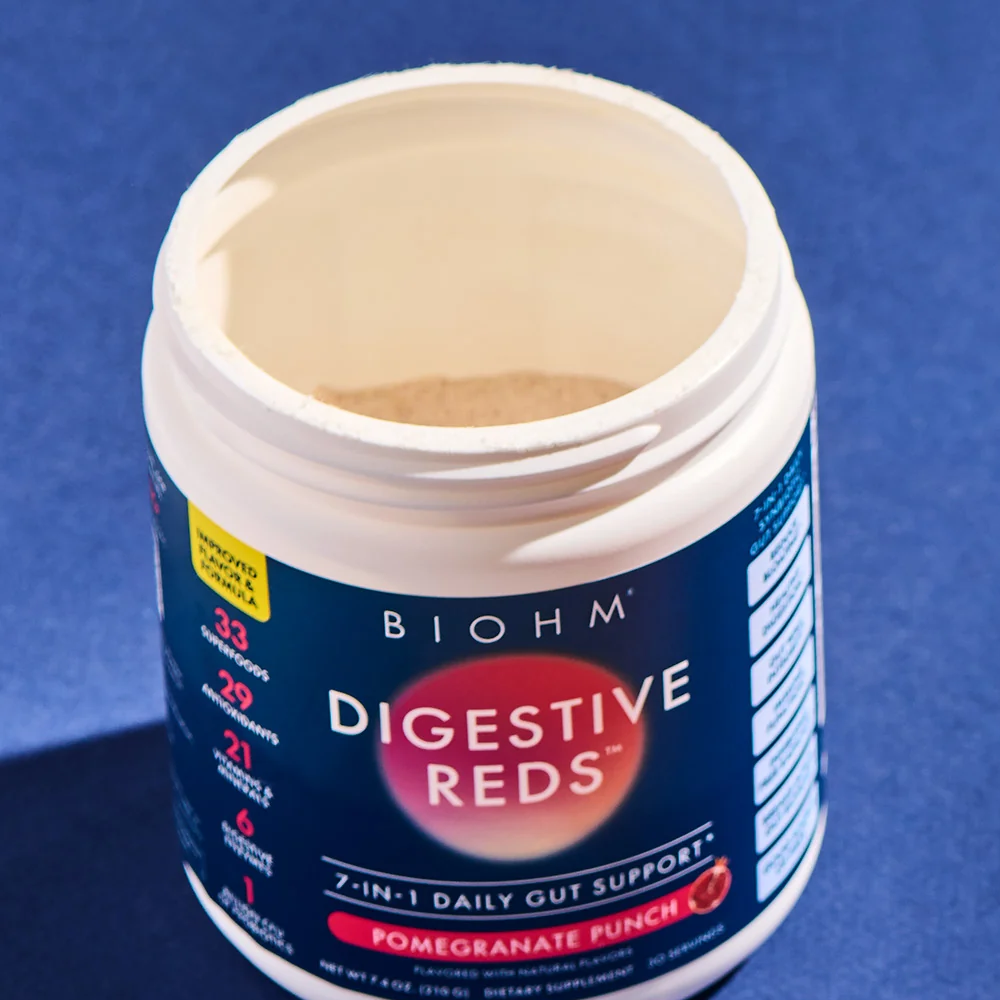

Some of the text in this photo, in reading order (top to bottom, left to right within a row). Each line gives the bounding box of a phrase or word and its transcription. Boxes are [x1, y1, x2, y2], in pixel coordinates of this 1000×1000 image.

[196, 527, 258, 578] IMPROVED
[199, 544, 254, 591] FLAVOR &
[201, 560, 258, 609] FORMULA
[214, 607, 249, 651] 33
[201, 624, 270, 682] SUPERFOODS
[218, 669, 253, 711] 29
[329, 659, 691, 751] DIGESTIVE
[202, 683, 279, 746] ANTIOXIDANTS
[224, 729, 251, 769] 21
[236, 808, 255, 837] 6
[243, 875, 254, 904] 1
[335, 871, 418, 906] 7-IN-1
[433, 891, 513, 911] DAILY
[525, 883, 581, 908] GUT
[372, 898, 679, 957] POMEGRANATE PUNCH
[484, 984, 542, 999] DIETARY
[546, 964, 634, 995] SUPPLEMENT
